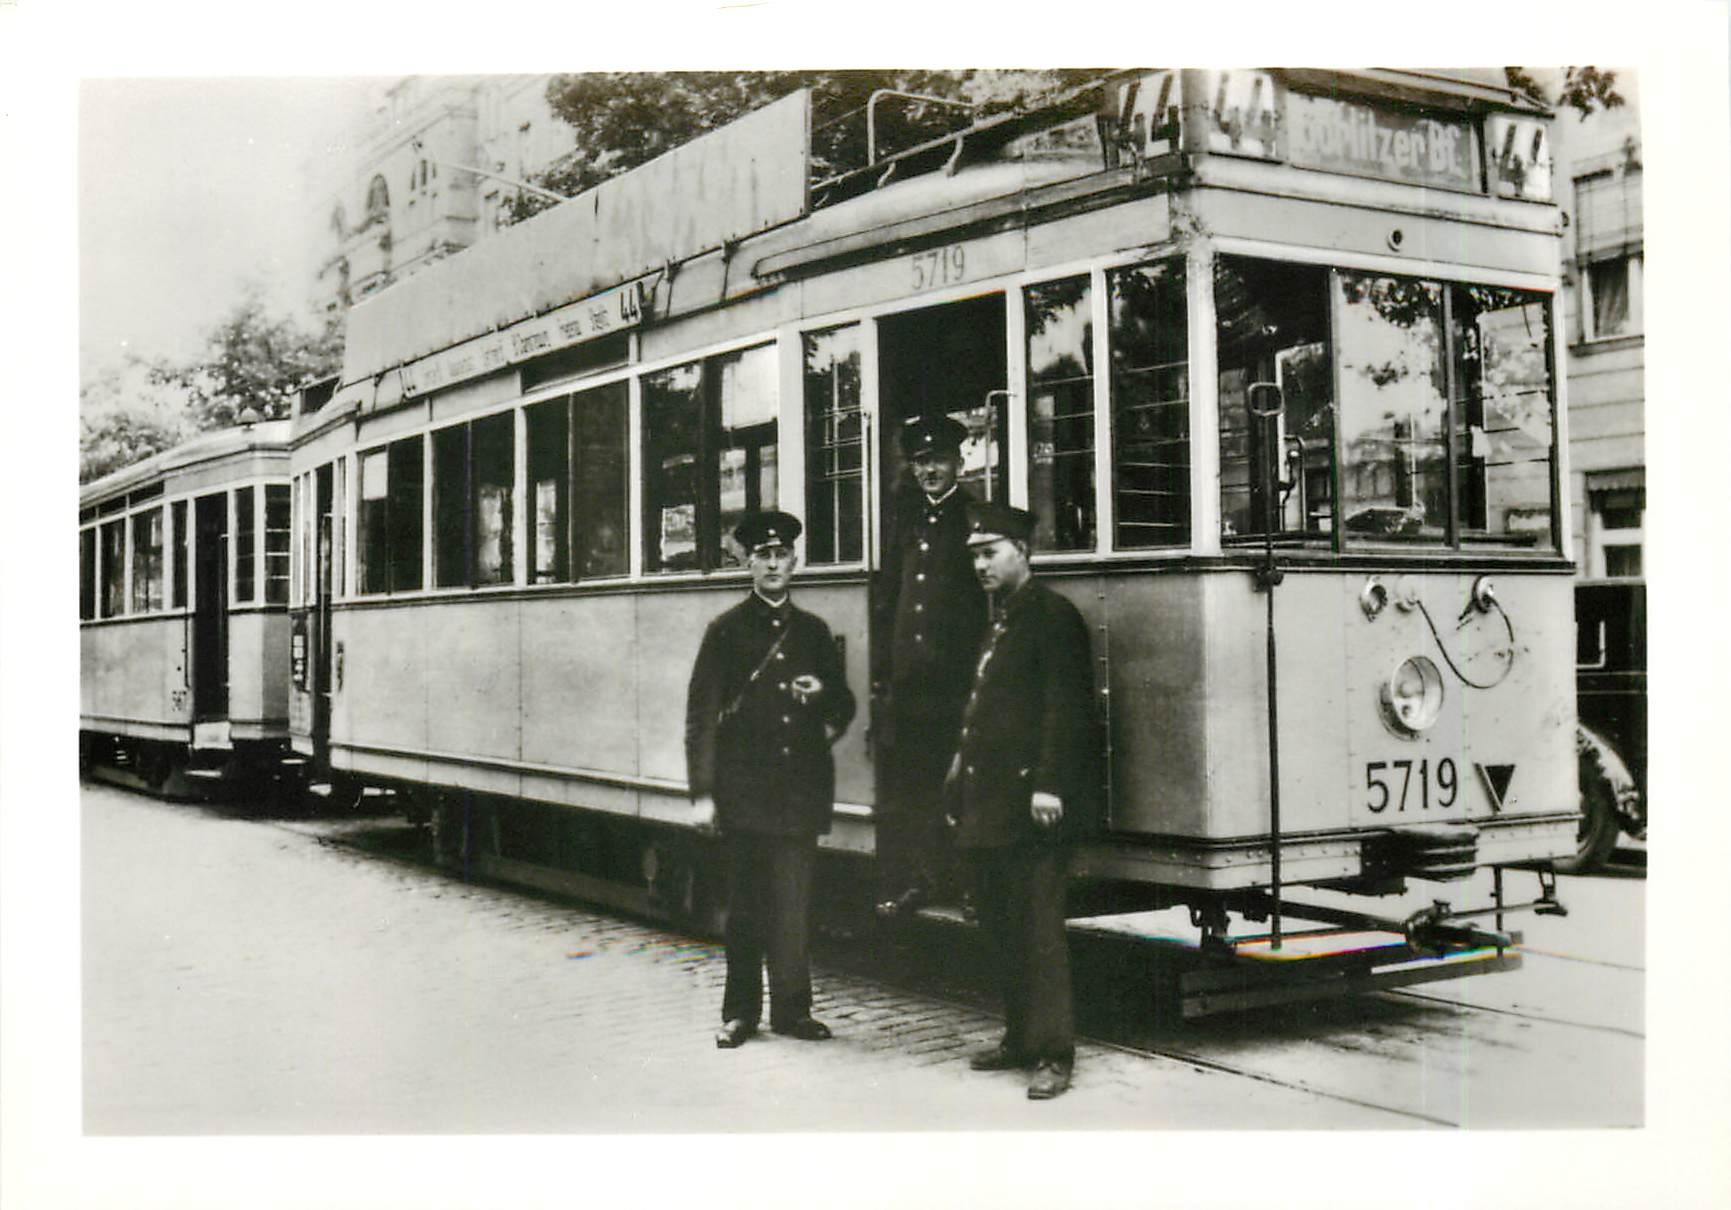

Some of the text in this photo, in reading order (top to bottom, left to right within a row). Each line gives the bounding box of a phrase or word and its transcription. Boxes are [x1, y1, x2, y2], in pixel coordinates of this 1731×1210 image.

[1117, 75, 1180, 153] 44
[1213, 72, 1273, 158] 44
[911, 244, 965, 290] 5719
[1367, 757, 1457, 813] 5719
